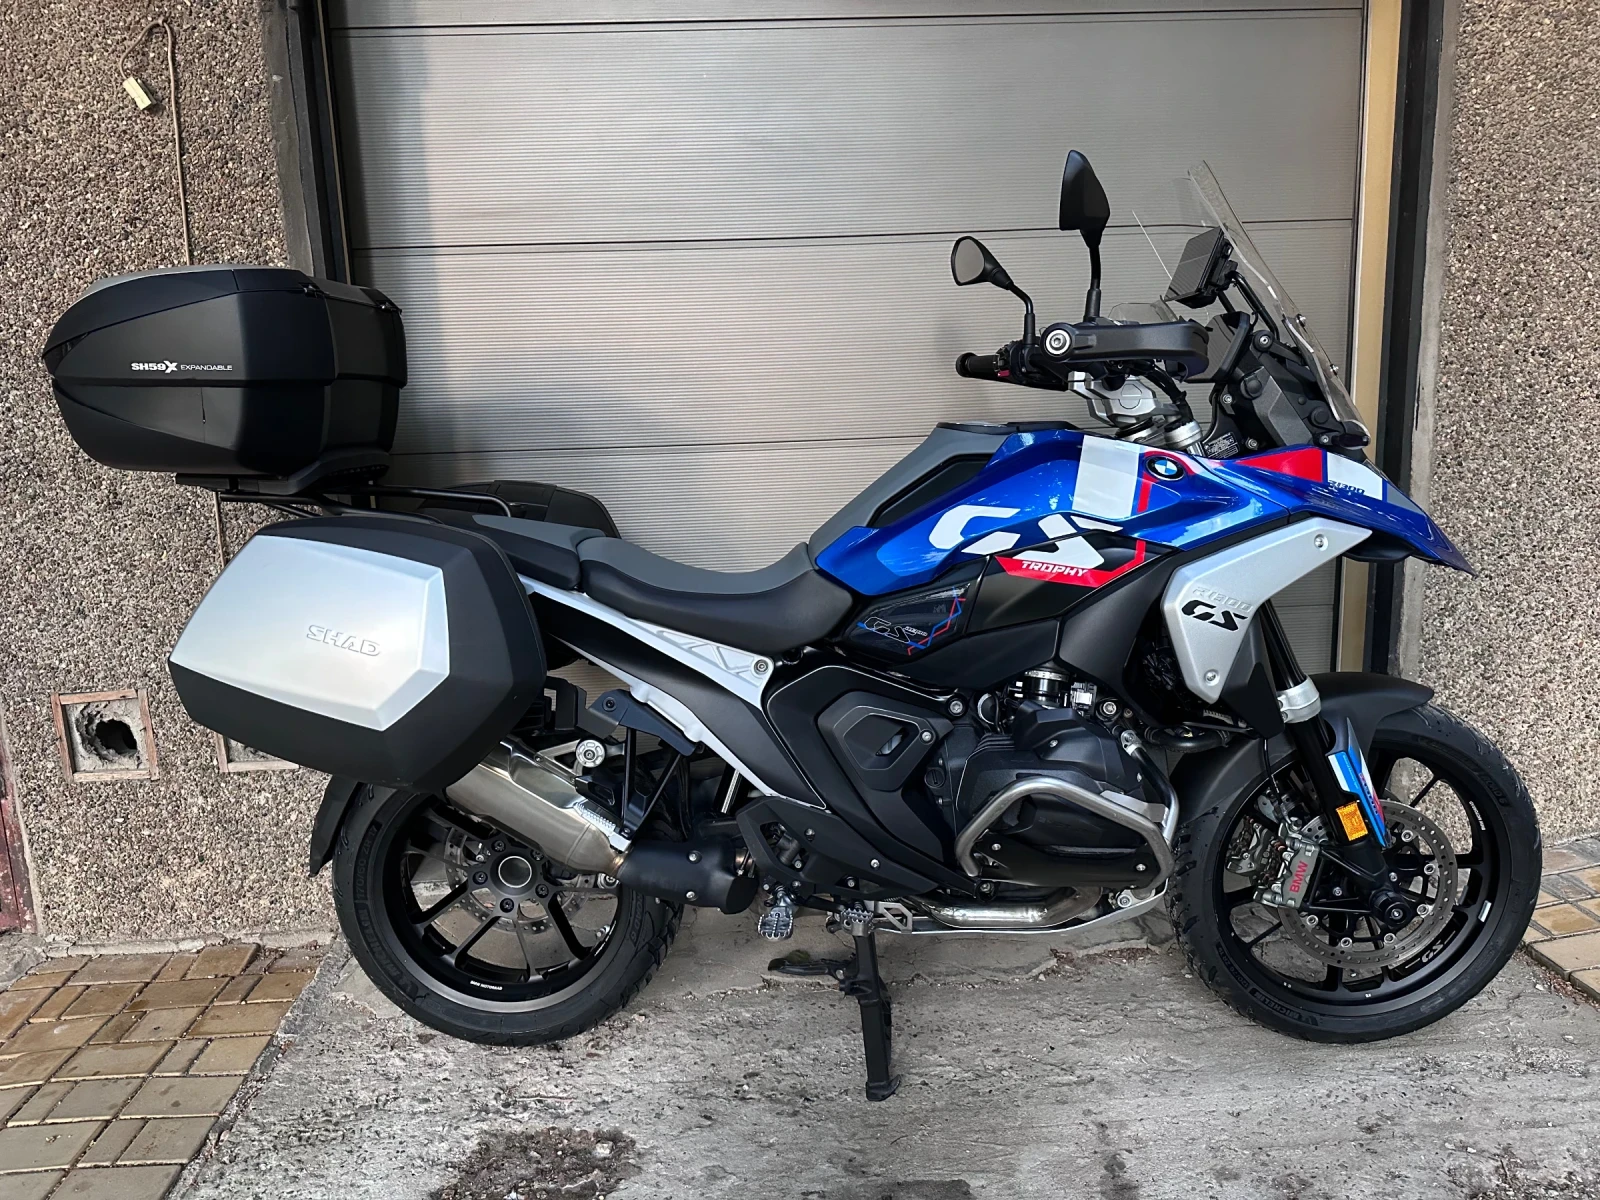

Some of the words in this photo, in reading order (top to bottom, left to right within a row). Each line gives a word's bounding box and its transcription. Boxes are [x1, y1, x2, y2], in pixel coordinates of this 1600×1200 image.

[131, 361, 178, 373] SH59X
[1021, 561, 1089, 577] TROPHY
[1181, 599, 1249, 631] GS
[306, 624, 382, 657] SHAD
[355, 858, 367, 900] 170/60
[361, 838, 373, 856] ZR
[1289, 860, 1308, 893] BMW
[1254, 990, 1301, 1019] MICHELIN
